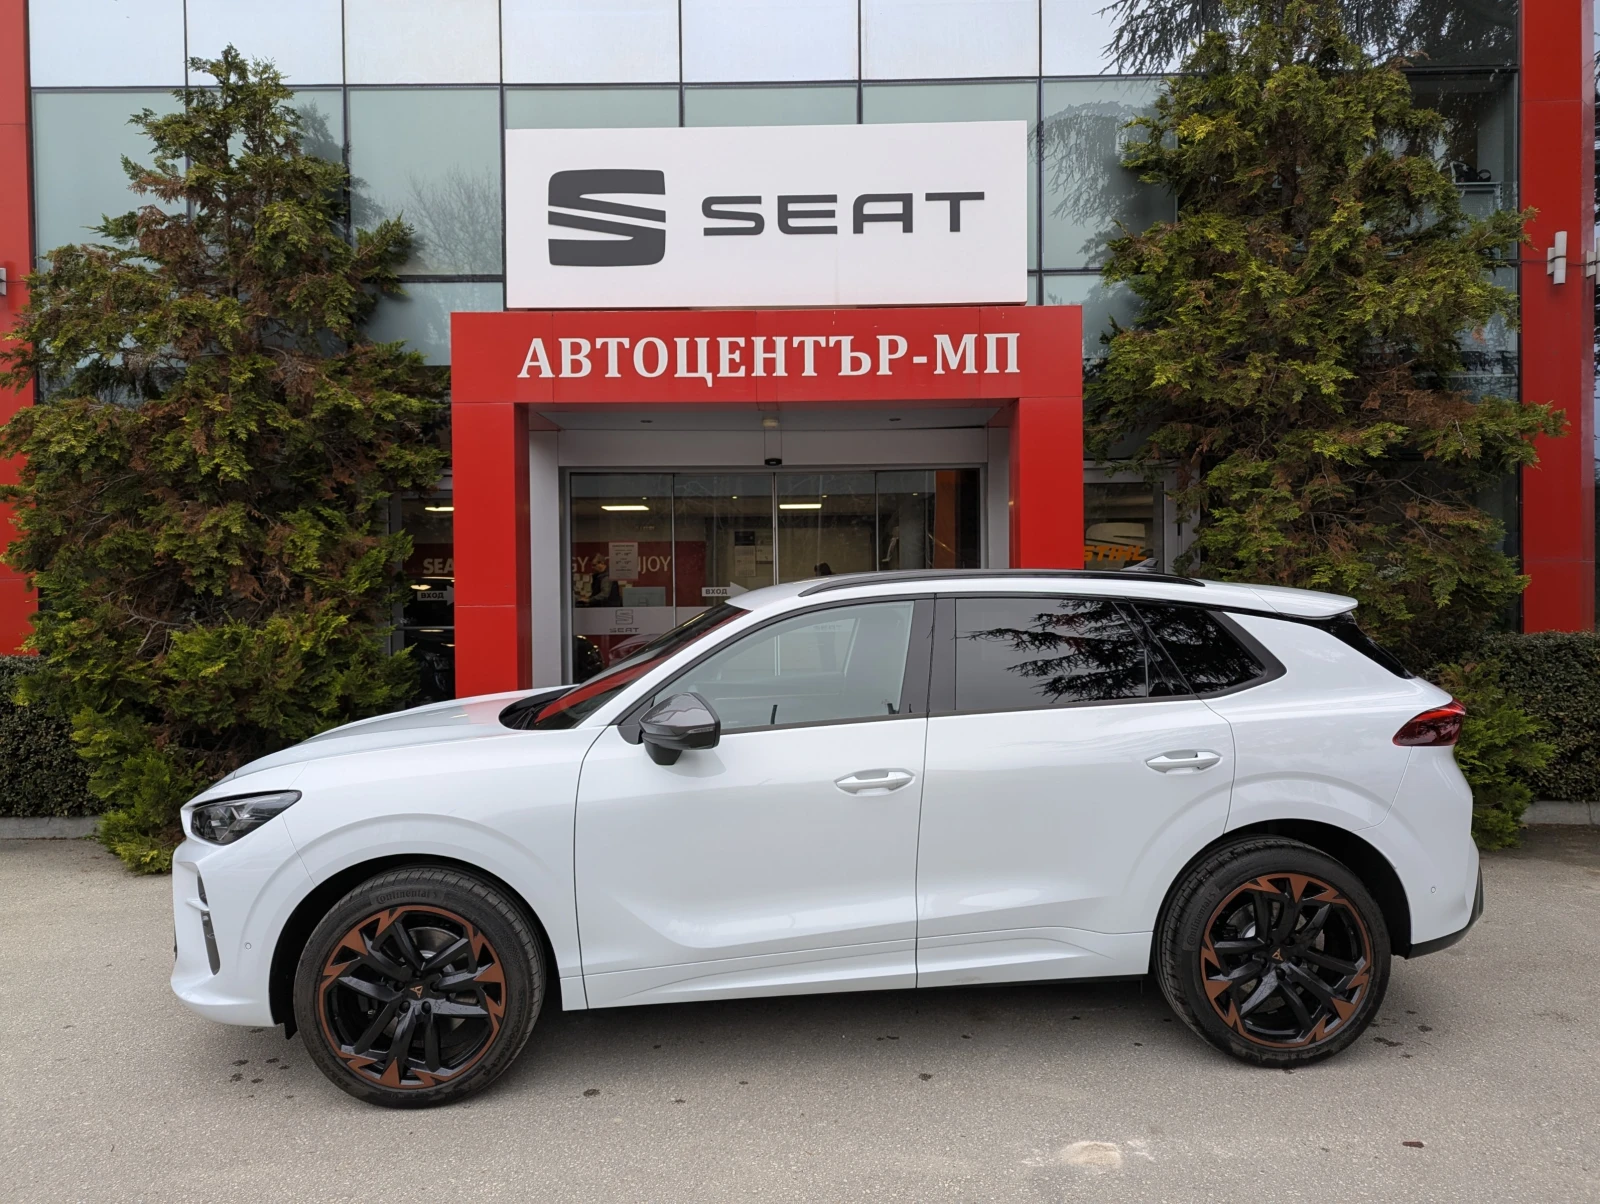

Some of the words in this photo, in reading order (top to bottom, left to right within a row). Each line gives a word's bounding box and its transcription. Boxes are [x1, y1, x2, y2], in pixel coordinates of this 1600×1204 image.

[702, 191, 985, 237] SEAT
[517, 332, 1021, 388] АВТОЦЕНТЪР-МП
[638, 556, 671, 574] JOY
[376, 889, 430, 905] Continental
